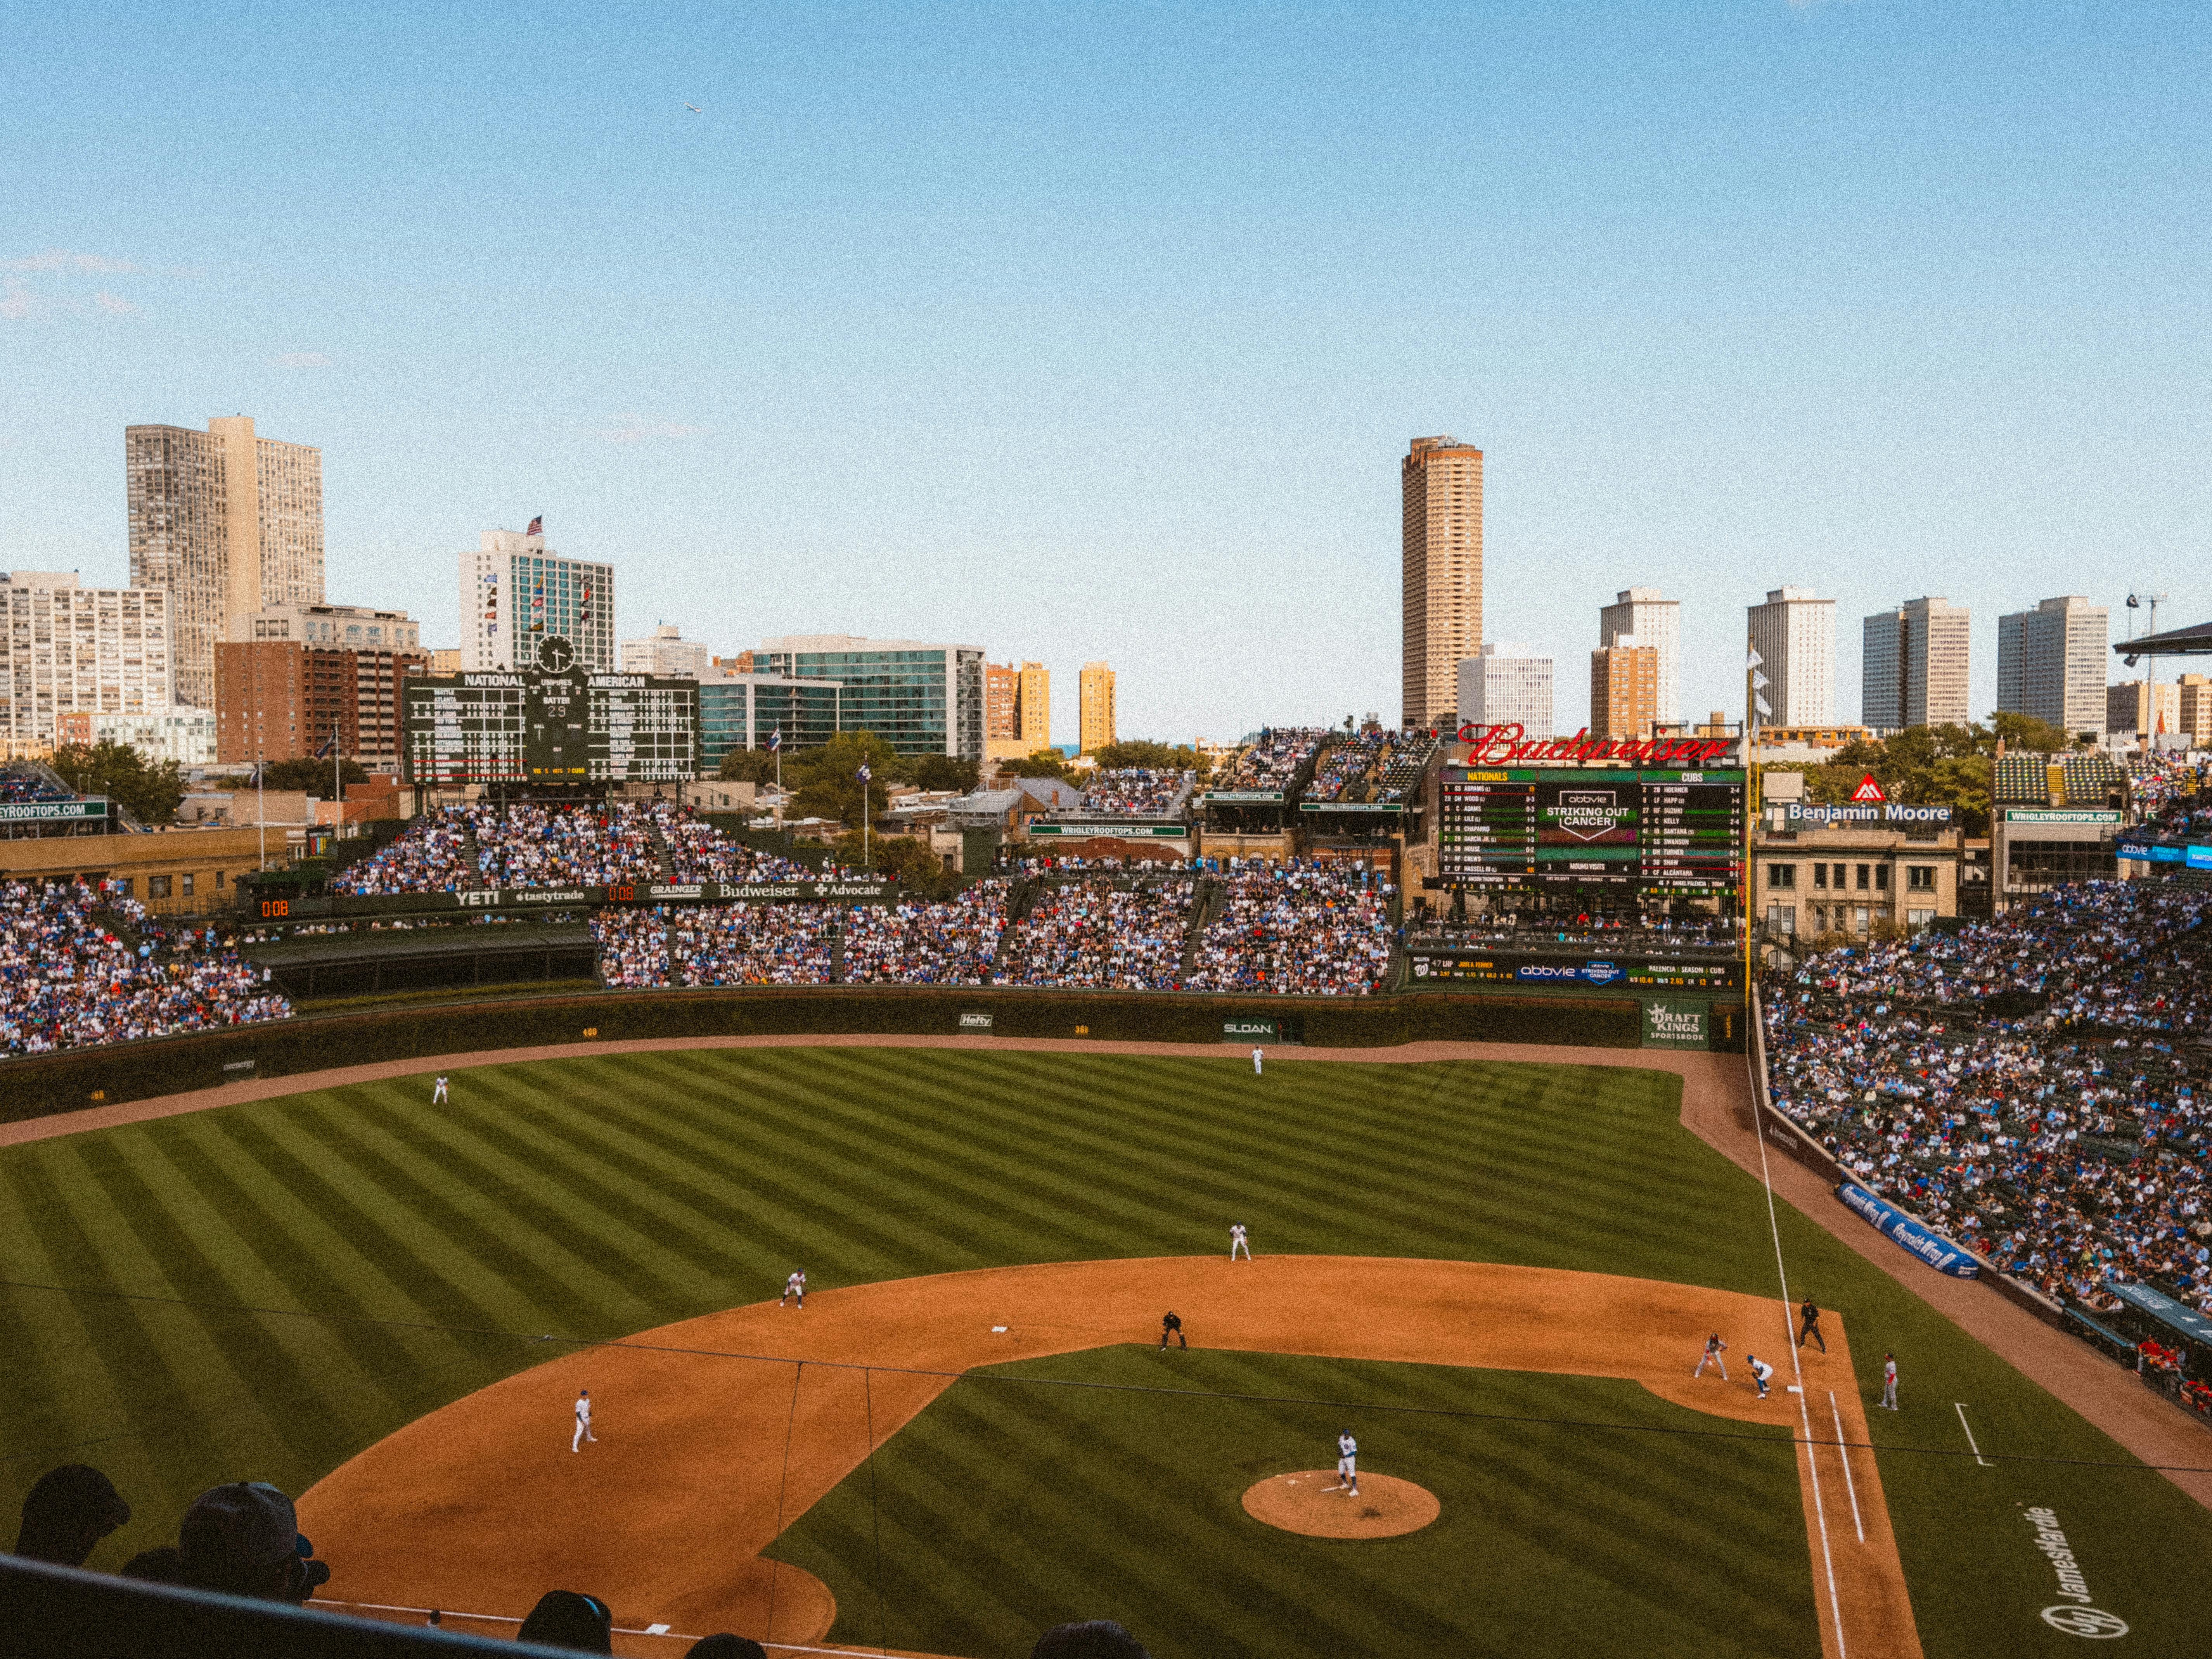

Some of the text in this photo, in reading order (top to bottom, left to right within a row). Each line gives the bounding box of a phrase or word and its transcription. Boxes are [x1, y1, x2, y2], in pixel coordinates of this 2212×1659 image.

[465, 675, 525, 686] NATIONAL
[588, 676, 645, 687] AMERICAN
[548, 706, 566, 717] 29
[1458, 723, 1727, 766] Budweiser
[1468, 772, 1508, 781] NATIONALS
[1682, 773, 1703, 782] CUBS
[1547, 807, 1629, 817] STRIKING OUT
[1789, 803, 1951, 823] Benjamin Moore
[2012, 812, 2117, 822] WRIGLEYROOFTOPS.COM
[1564, 817, 1611, 825] CANCER
[2122, 844, 2148, 855] abbvie
[650, 885, 702, 895] GRAINGER
[720, 884, 798, 897] Budweiser
[830, 884, 881, 896] Advocate
[456, 891, 499, 906] YETI
[524, 889, 585, 903] tastytrade
[1521, 965, 1575, 976] abbvie
[963, 1015, 990, 1026] Hefty
[1651, 1013, 1701, 1024] DRAFT
[1657, 1023, 1700, 1032] KINGS
[1651, 1033, 1704, 1041] SPORTSBOOK
[1920, 1240, 1943, 1265] Wrap
[2024, 1507, 2093, 1603] JamesHardie
